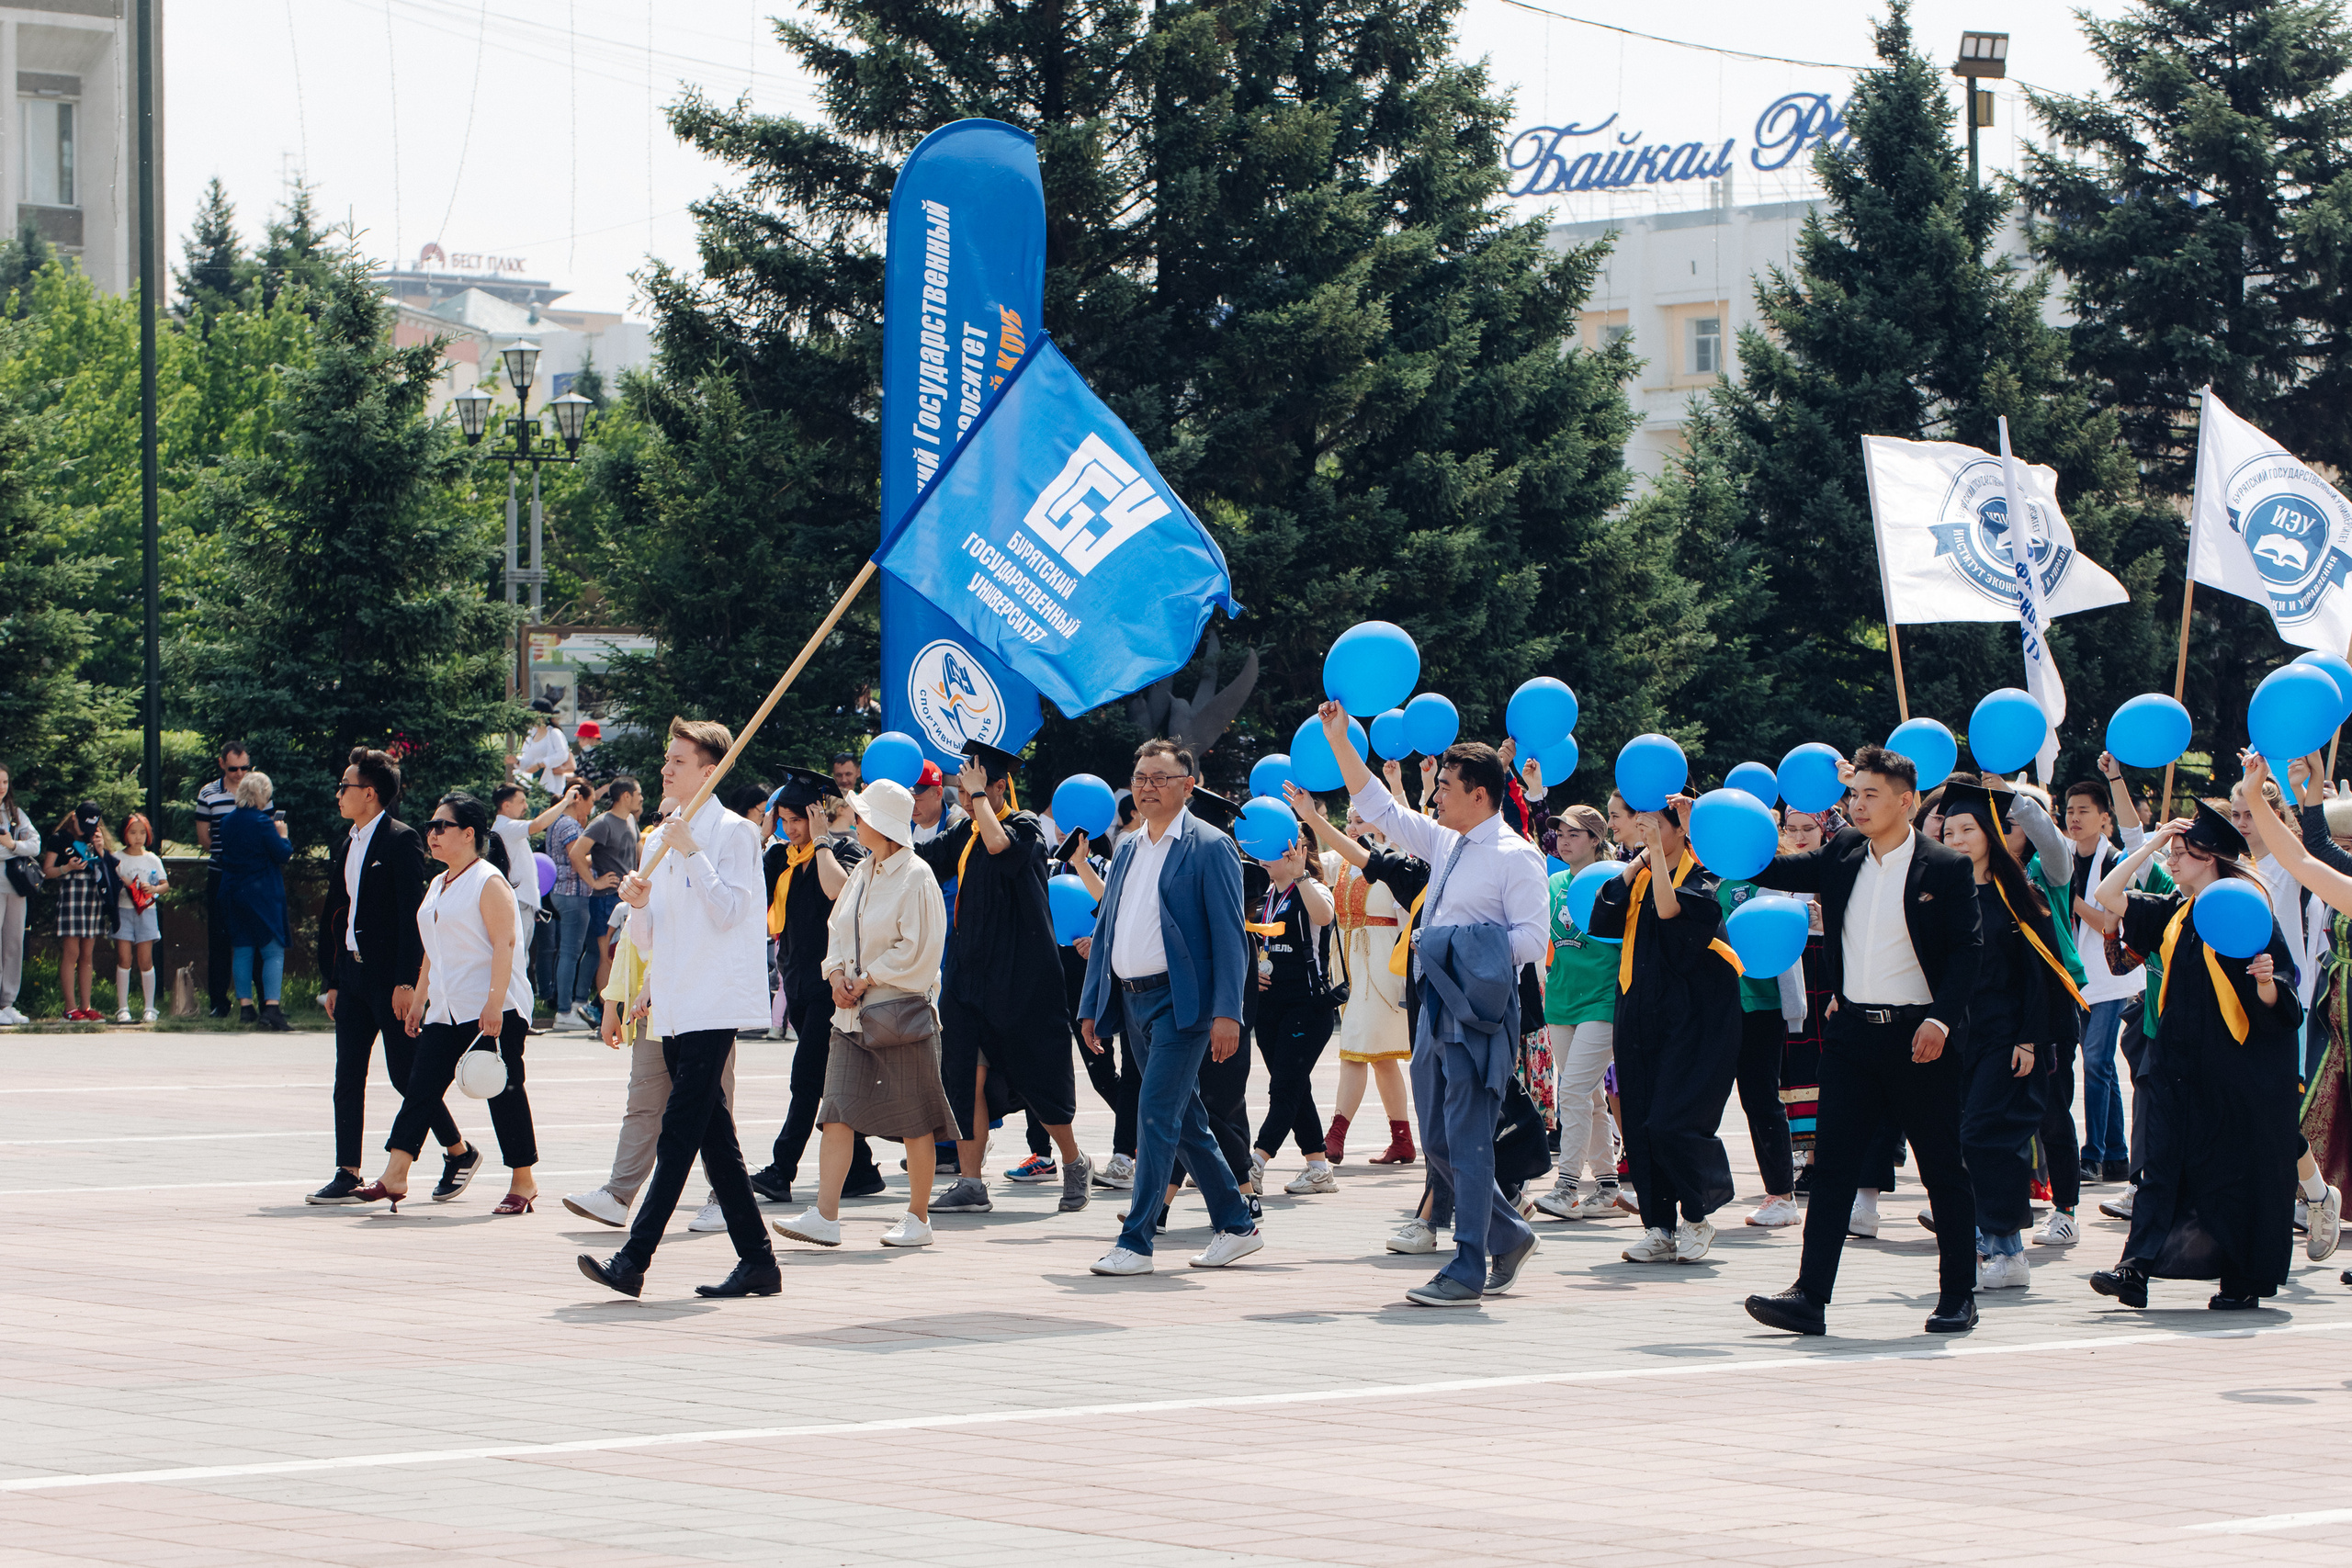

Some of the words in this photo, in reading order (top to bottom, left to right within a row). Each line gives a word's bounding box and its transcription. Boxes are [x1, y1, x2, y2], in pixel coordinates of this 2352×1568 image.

[451, 254, 483, 269] БЕСТ
[912, 199, 950, 445] Государственный
[2232, 468, 2268, 504] БУРЯТСКИЙ
[2268, 467, 2338, 502] ГОСУДАРСТВЕННЫЙ
[2269, 504, 2317, 536] ИЭУ
[961, 531, 1082, 640] ГОСУДАРСТВЕННЫЙ
[1006, 529, 1079, 601] БУРЯТСКИЙ
[1952, 528, 1986, 578] ИНСТИТУТ
[1984, 572, 2018, 594] ЭКОНО
[2298, 555, 2339, 609] УПРАВЛЕНИЯ
[966, 571, 1049, 644] УНИВЕРСИТЕТ
[974, 717, 991, 741] ЛУБ
